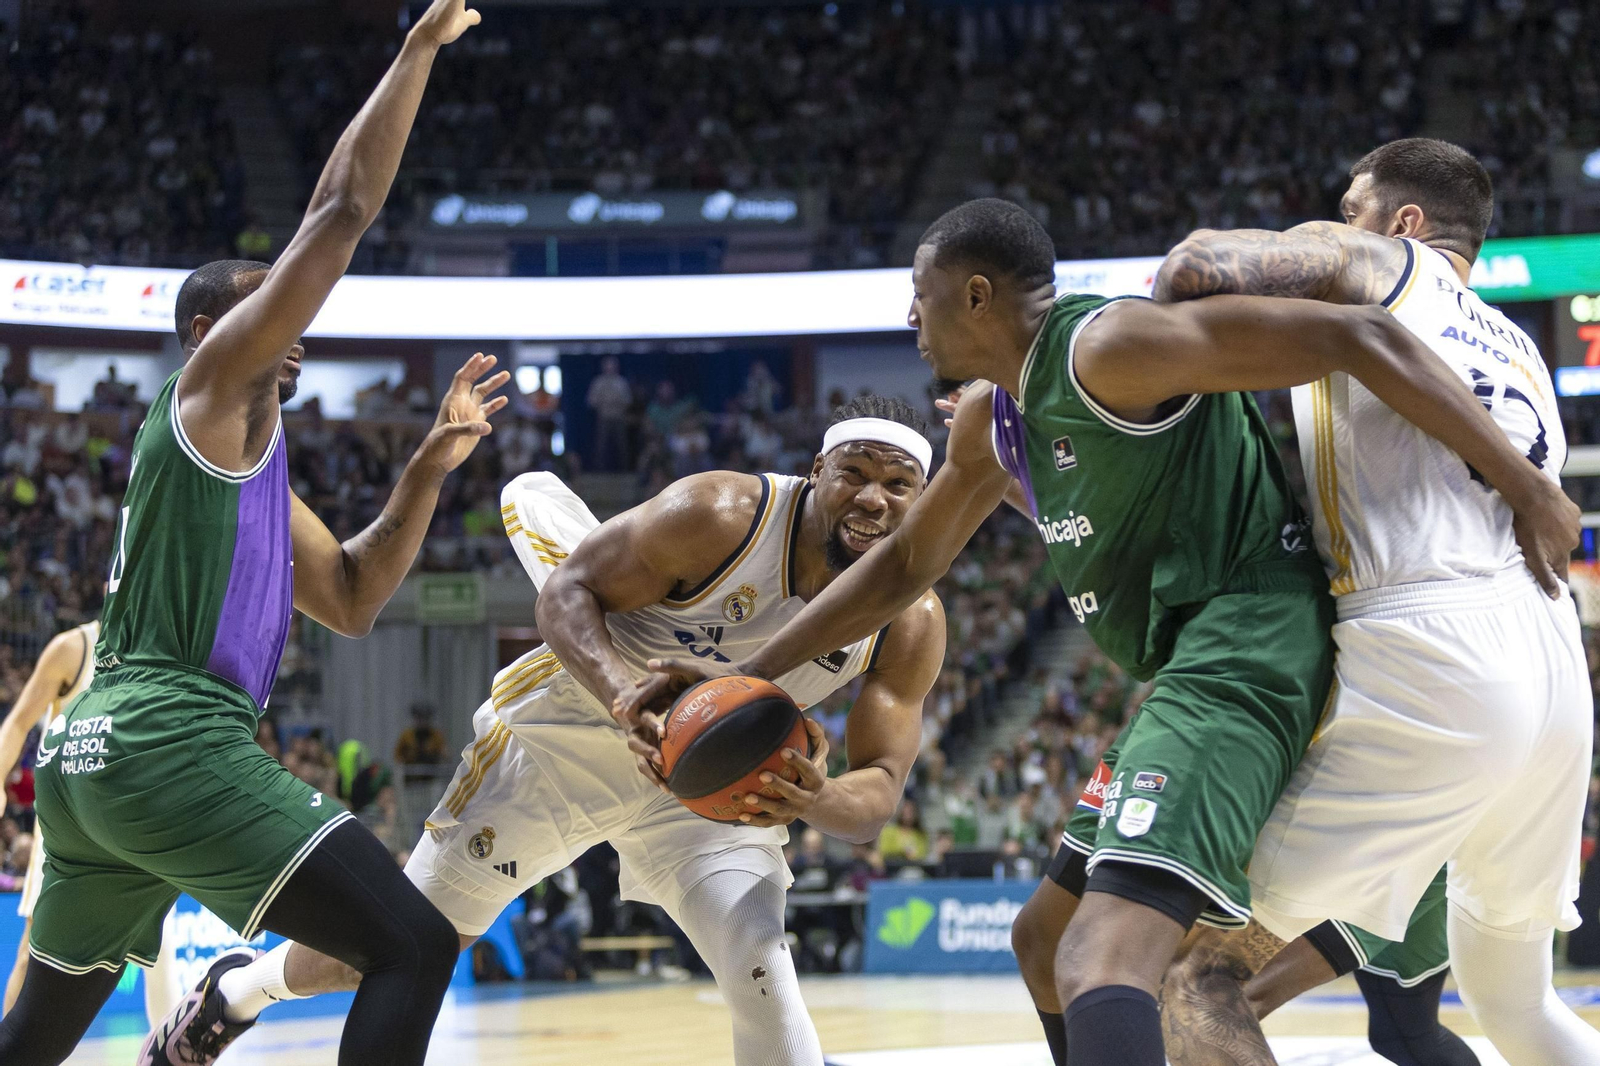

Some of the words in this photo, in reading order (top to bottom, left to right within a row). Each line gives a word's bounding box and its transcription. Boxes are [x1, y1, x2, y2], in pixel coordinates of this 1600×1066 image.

[1034, 510, 1094, 548] nicaja
[818, 656, 840, 671] ndesa
[69, 716, 113, 737] COSTA
[80, 738, 109, 755] SOL
[61, 757, 106, 775] MÁLAGA
[1136, 780, 1157, 789] acb
